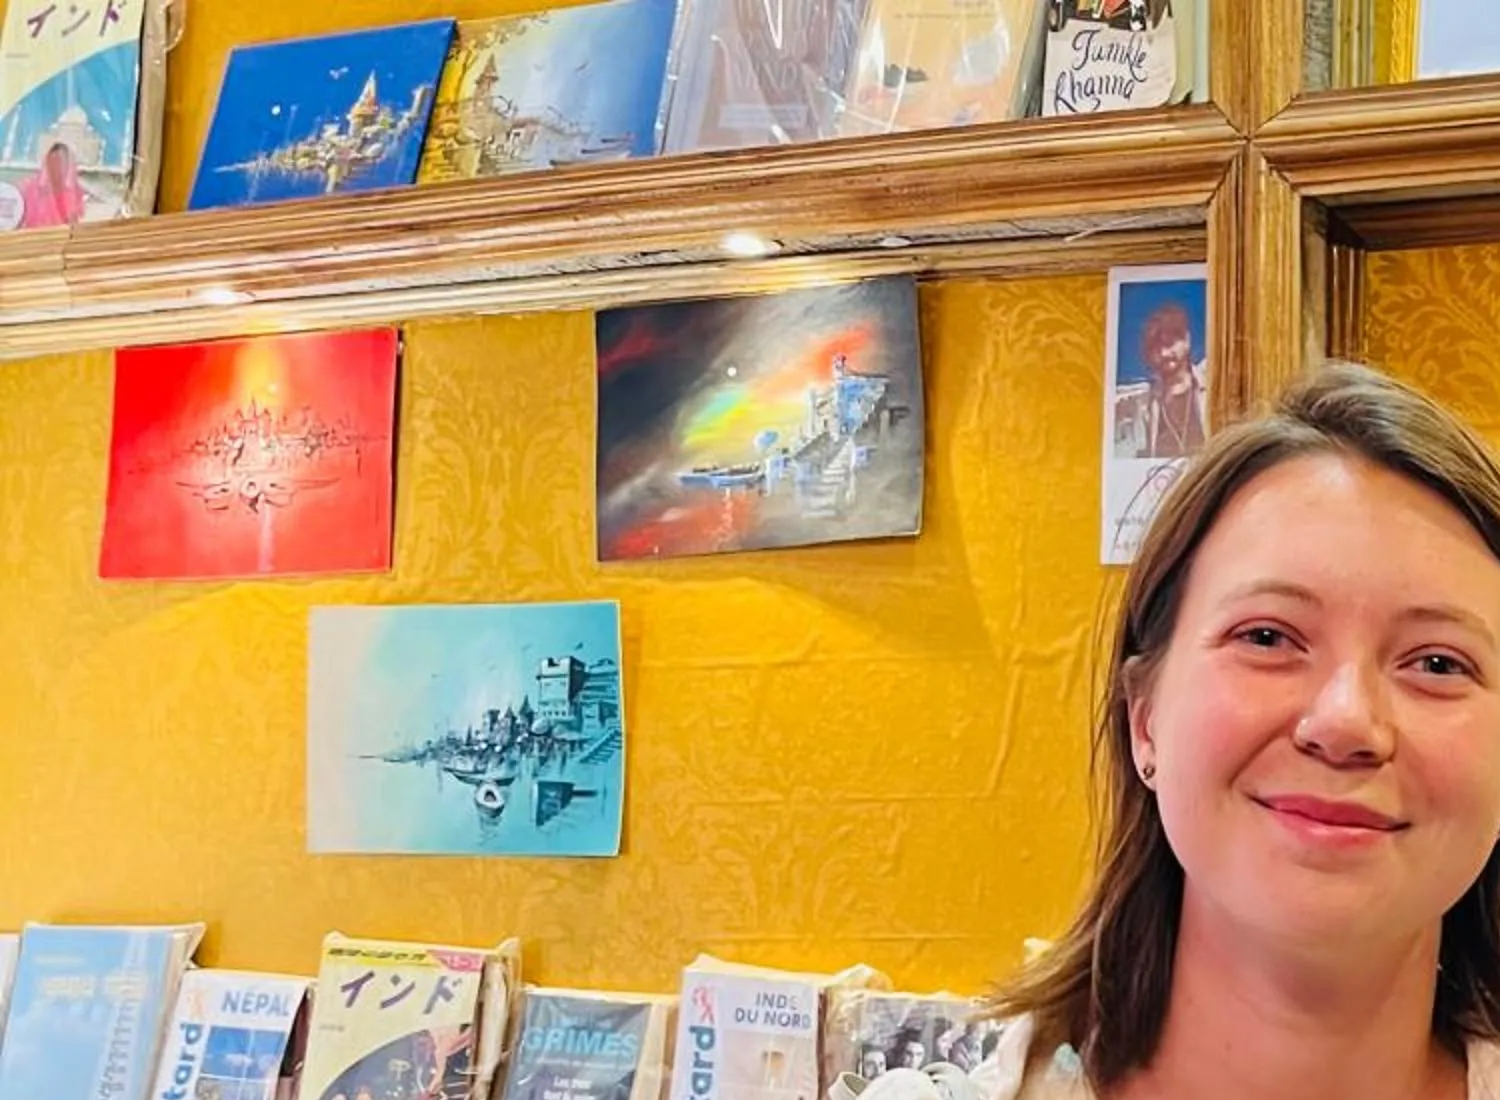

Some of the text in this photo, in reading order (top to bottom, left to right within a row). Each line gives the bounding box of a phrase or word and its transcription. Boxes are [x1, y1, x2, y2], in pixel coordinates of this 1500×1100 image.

[27, 0, 127, 38] インド
[1054, 70, 1135, 113] Khanna
[340, 969, 463, 1014] インド
[734, 1007, 812, 1030] DU NORD
[525, 1026, 639, 1059] GRIMES
